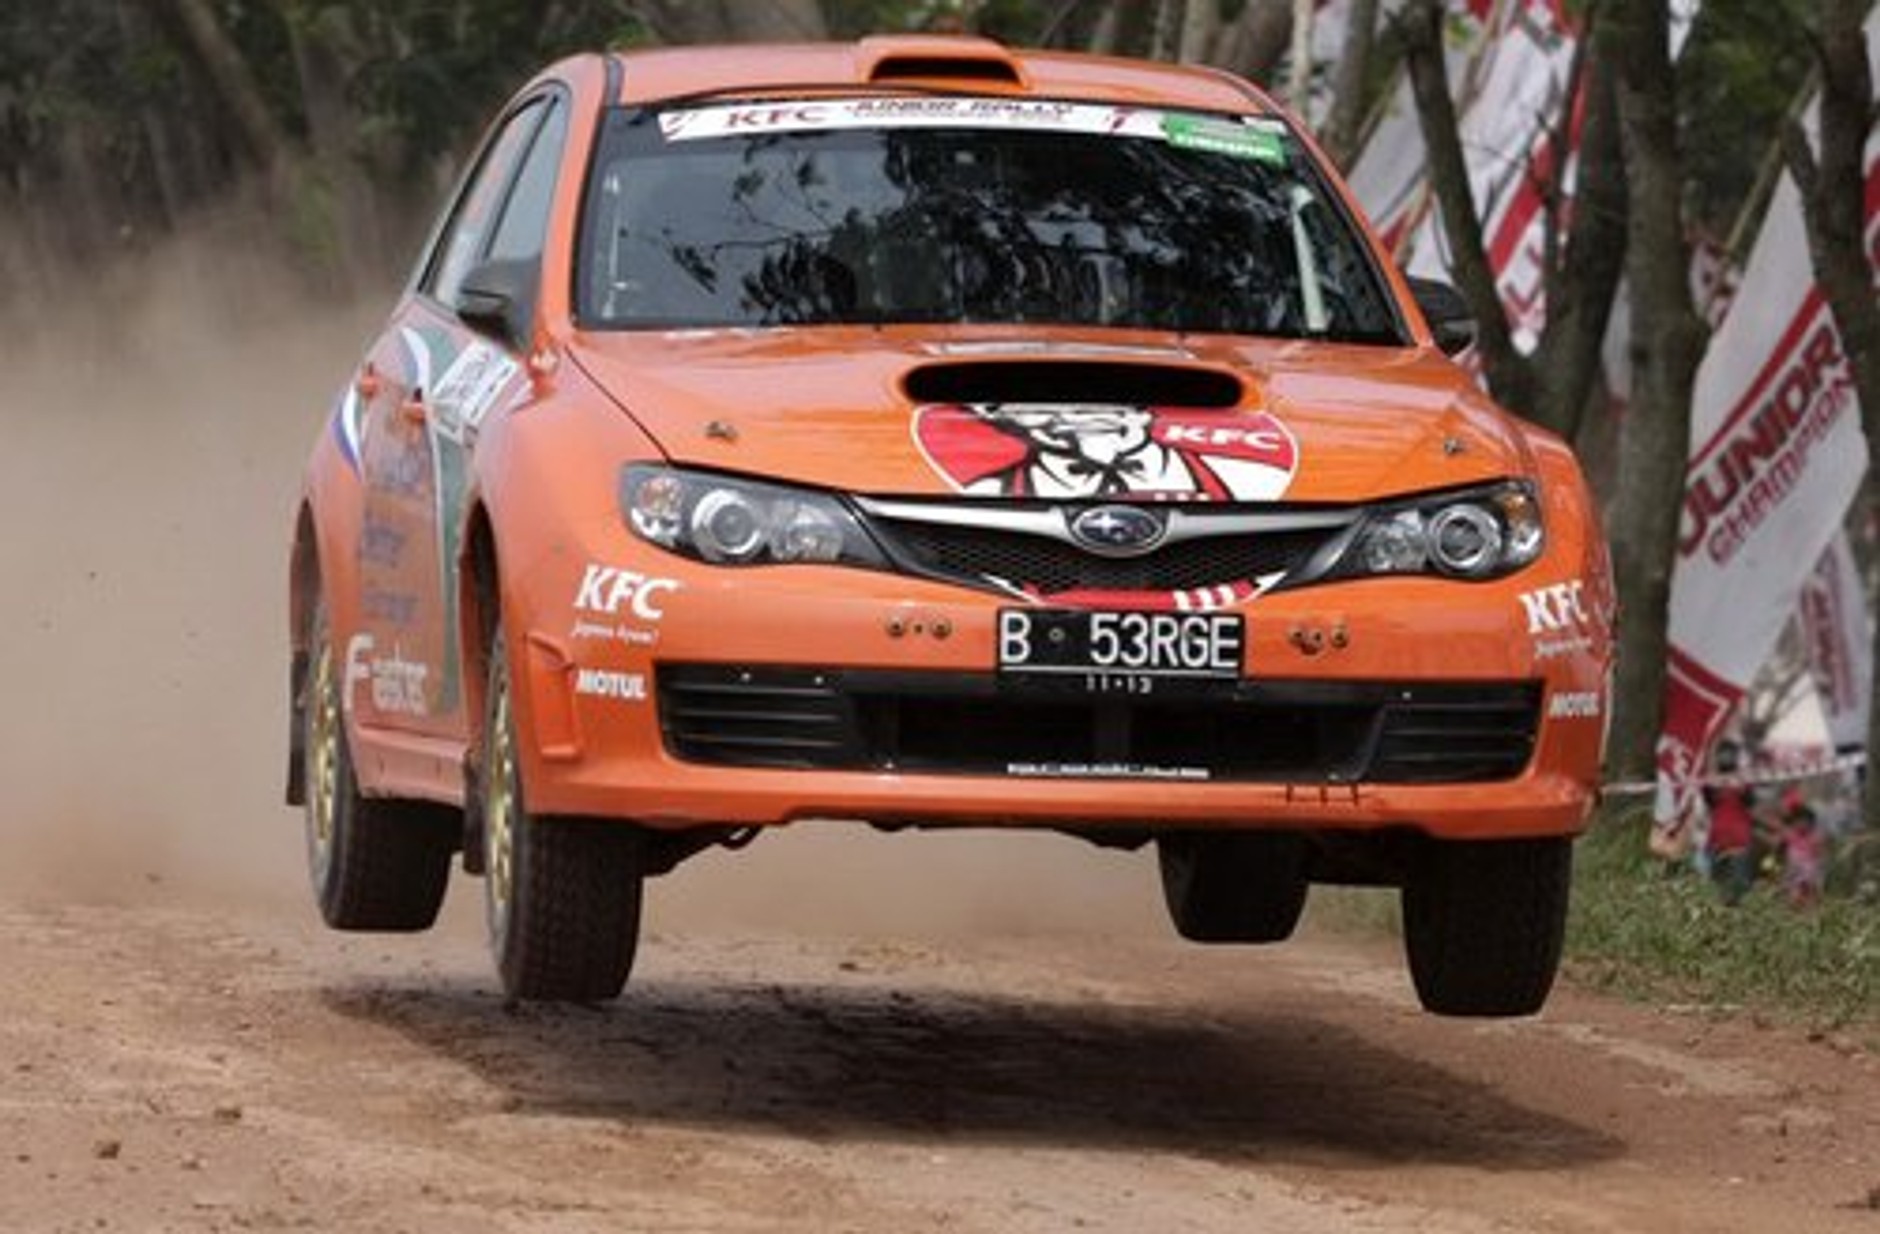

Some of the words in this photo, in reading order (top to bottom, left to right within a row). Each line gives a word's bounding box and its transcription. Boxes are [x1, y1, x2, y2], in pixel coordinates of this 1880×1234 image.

[725, 104, 828, 129] KFC
[1164, 423, 1283, 450] KFC
[1680, 324, 1842, 558] JUNIOR
[573, 564, 681, 621] KFC
[1518, 579, 1588, 634] KFC
[1000, 611, 1031, 664] B
[576, 668, 647, 700] MOTUL
